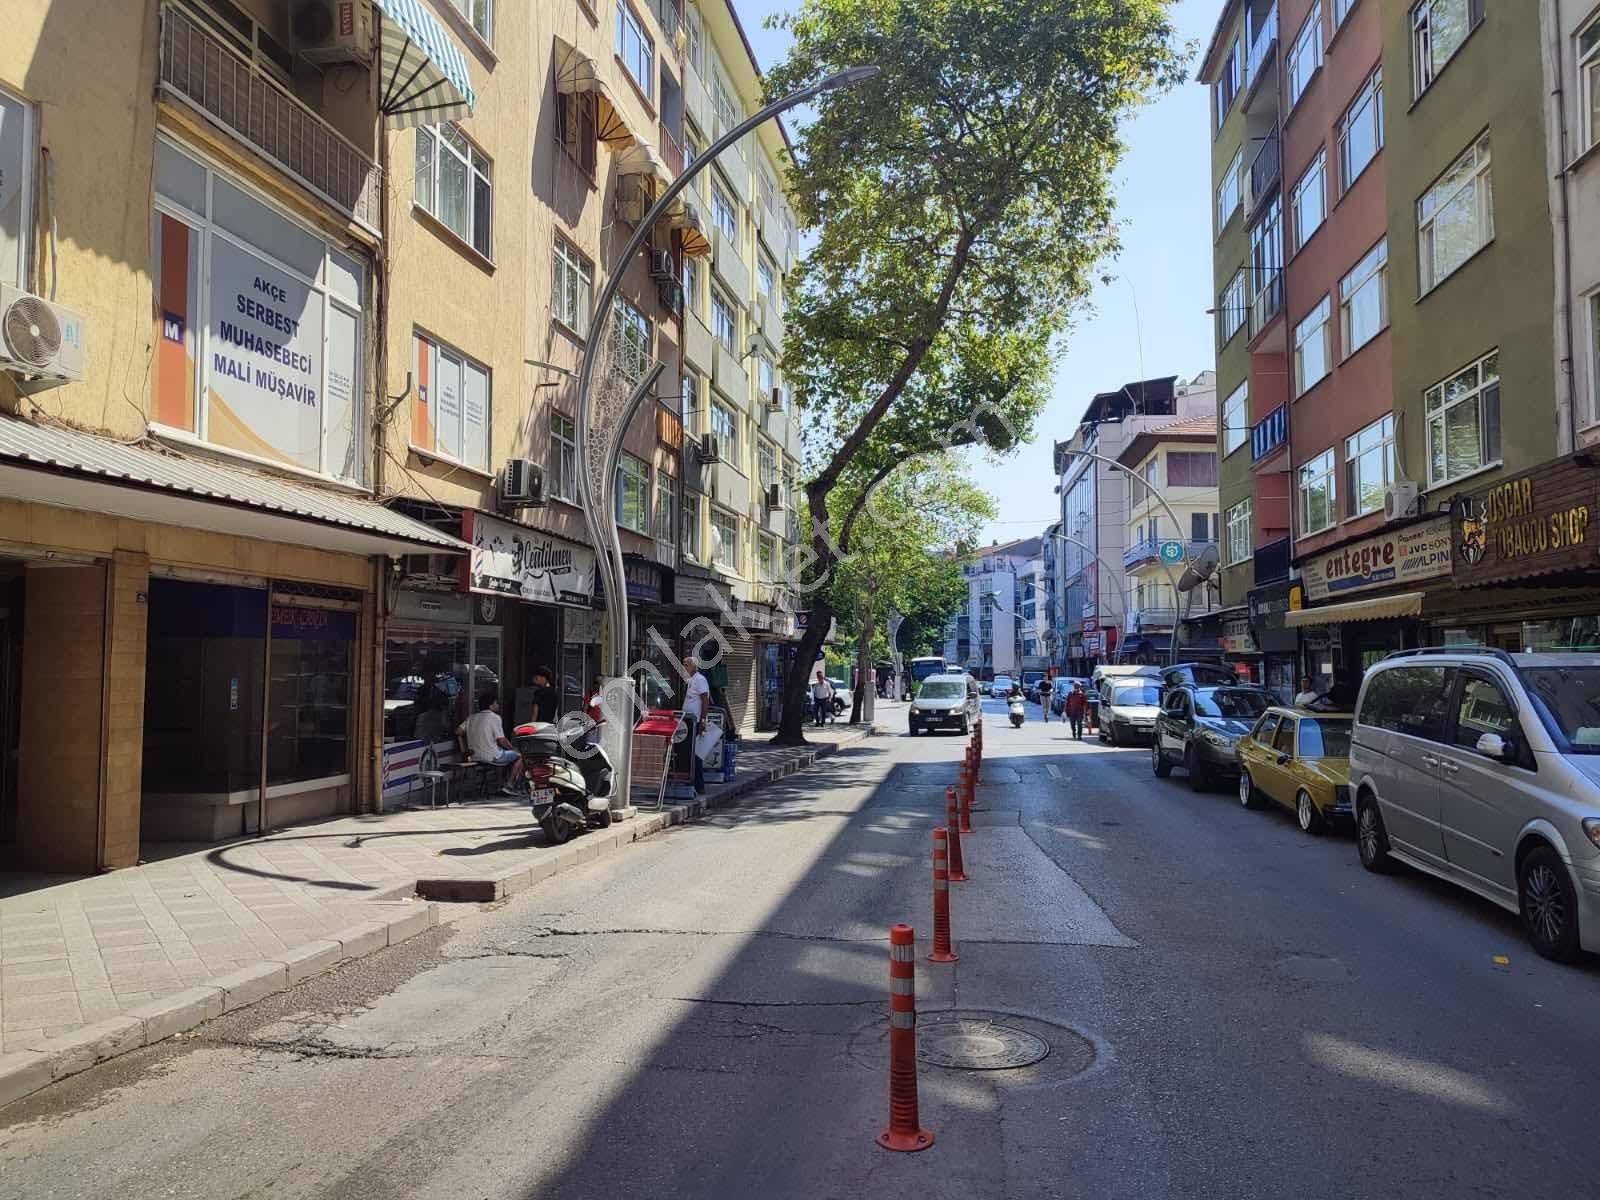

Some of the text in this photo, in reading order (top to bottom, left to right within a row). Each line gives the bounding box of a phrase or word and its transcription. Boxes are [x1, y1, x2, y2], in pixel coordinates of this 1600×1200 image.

[253, 276, 287, 303] AKÇE
[237, 294, 300, 338] SERBEST
[220, 320, 312, 375] MUHASEBECİ
[214, 353, 251, 384] MALİ
[255, 368, 316, 407] MÜŞAVİR
[1488, 477, 1533, 523] OSCAR
[1409, 536, 1456, 555] JVC SONY
[1491, 505, 1590, 560] TOBACCO SHOP
[1326, 539, 1394, 578] entegre
